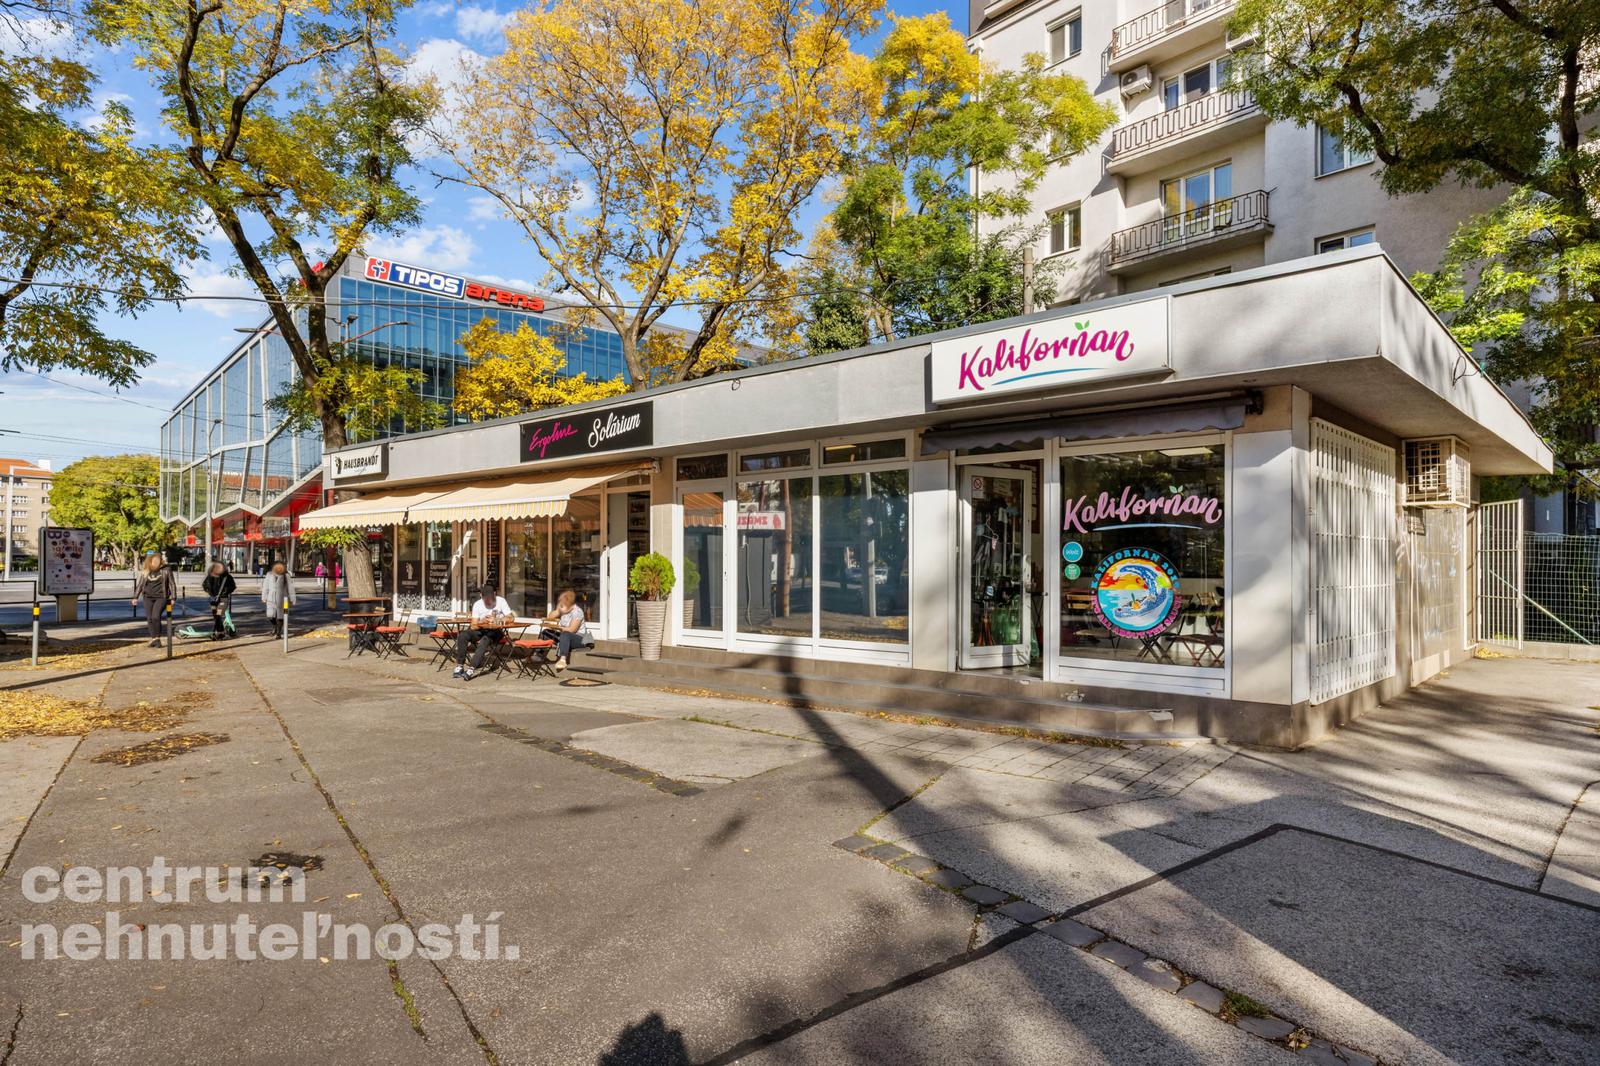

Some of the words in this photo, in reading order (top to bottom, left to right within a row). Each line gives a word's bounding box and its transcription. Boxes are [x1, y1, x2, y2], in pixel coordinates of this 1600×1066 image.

[395, 265, 460, 295] TIPOS
[465, 283, 546, 313] arena
[958, 327, 1135, 392] Kalifornan
[587, 411, 641, 448] Solárium
[343, 455, 379, 470] HAUSBRANDT
[1063, 485, 1223, 534] Kalifornan
[1091, 549, 1160, 589] KALIFORNAN
